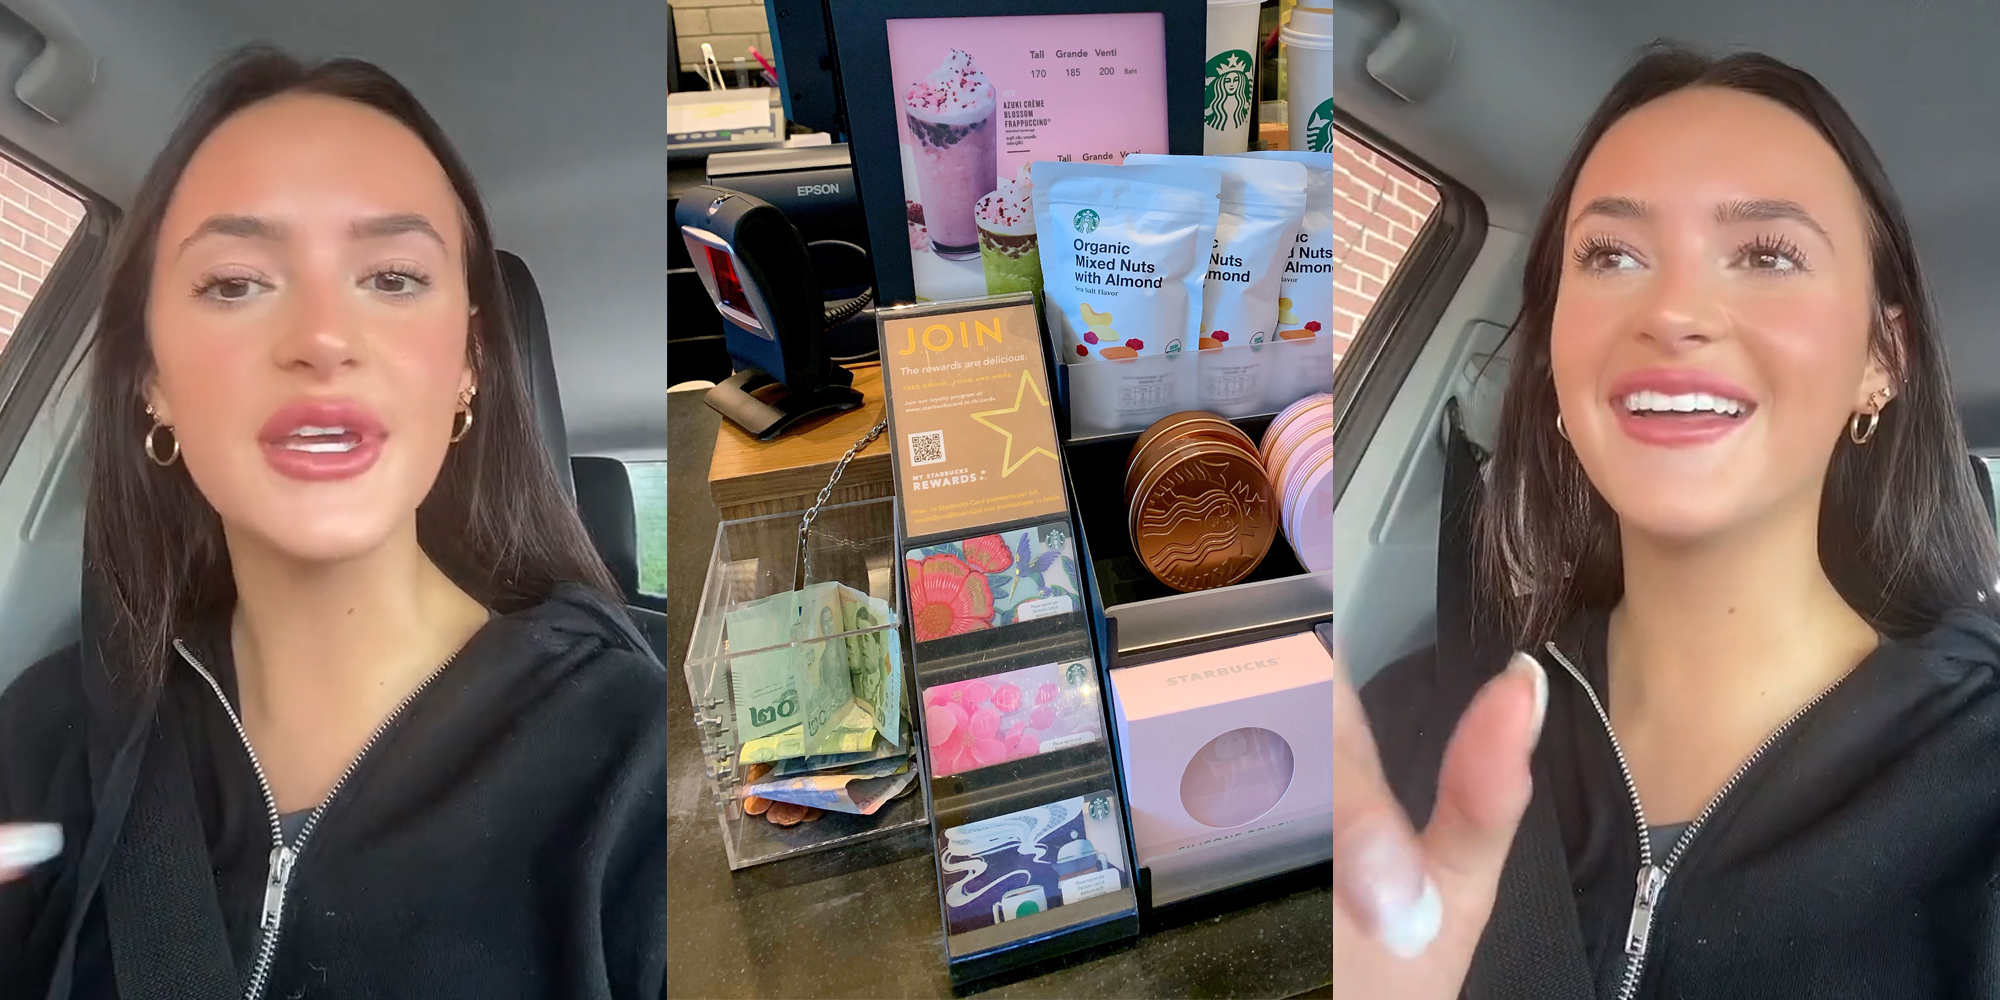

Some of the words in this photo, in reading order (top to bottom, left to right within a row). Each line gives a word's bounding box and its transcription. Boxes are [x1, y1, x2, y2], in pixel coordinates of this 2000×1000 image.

[1029, 50, 1045, 59] Tall
[1055, 49, 1088, 59] Grande
[1094, 48, 1117, 57] Venti
[1030, 70, 1046, 78] 170
[1066, 68, 1081, 77] 185
[1099, 67, 1114, 76] 200
[1003, 101, 1022, 109] AZUKI
[1024, 99, 1044, 108] CRÈME
[1004, 110, 1034, 118] BLOSSOM
[1082, 152, 1113, 161] Grande
[797, 183, 840, 196] EPSON
[1074, 238, 1130, 255] Organic
[1300, 246, 1333, 258] Nuts
[1075, 254, 1115, 270] Mixed
[1120, 259, 1155, 273] Nuts
[1210, 253, 1242, 267] Nuts
[1285, 261, 1333, 273] Almon
[1075, 271, 1101, 284] with
[1105, 274, 1163, 288] Almond
[1085, 286, 1096, 294] Salt
[898, 318, 1002, 355] JOIN
[900, 366, 919, 376] The
[922, 360, 962, 373] rewards
[964, 360, 980, 368] are
[983, 353, 1028, 365] delicious.
[926, 468, 968, 478] STARBUCKS
[913, 473, 977, 491] REWARDS
[938, 501, 968, 511] Starbucks
[970, 498, 985, 506] Card
[986, 493, 1016, 504] payments
